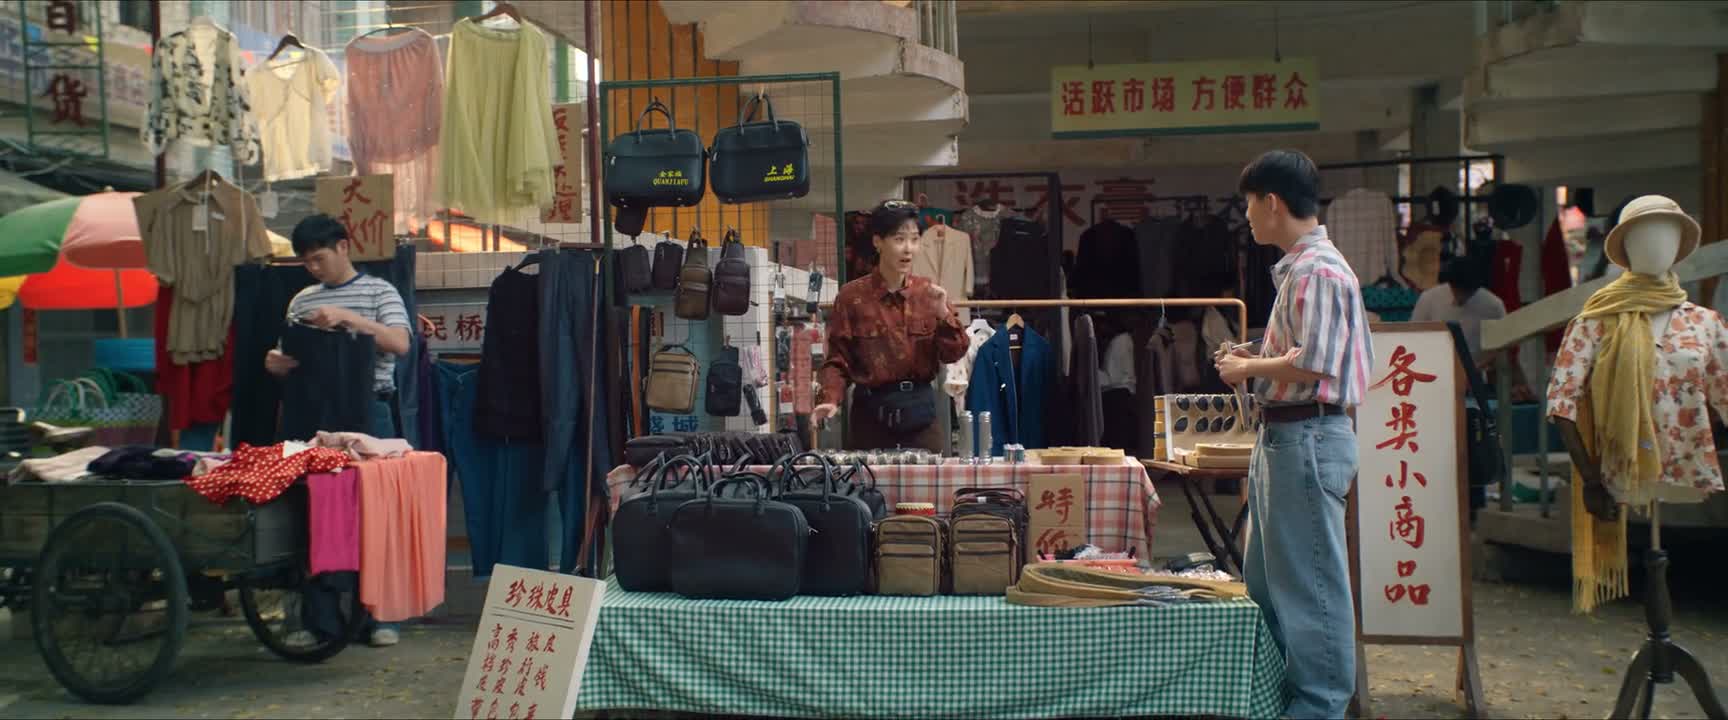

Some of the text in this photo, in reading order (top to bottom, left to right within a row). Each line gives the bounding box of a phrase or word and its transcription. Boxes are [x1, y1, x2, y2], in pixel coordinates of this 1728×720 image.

[47, 0, 88, 127] 百货
[1061, 71, 1309, 116] 活跃市场 方便群众
[767, 163, 794, 174] 上海
[343, 178, 371, 204] 大
[1368, 345, 1438, 606] 各类小商品
[504, 578, 574, 618] 珍珠皮具
